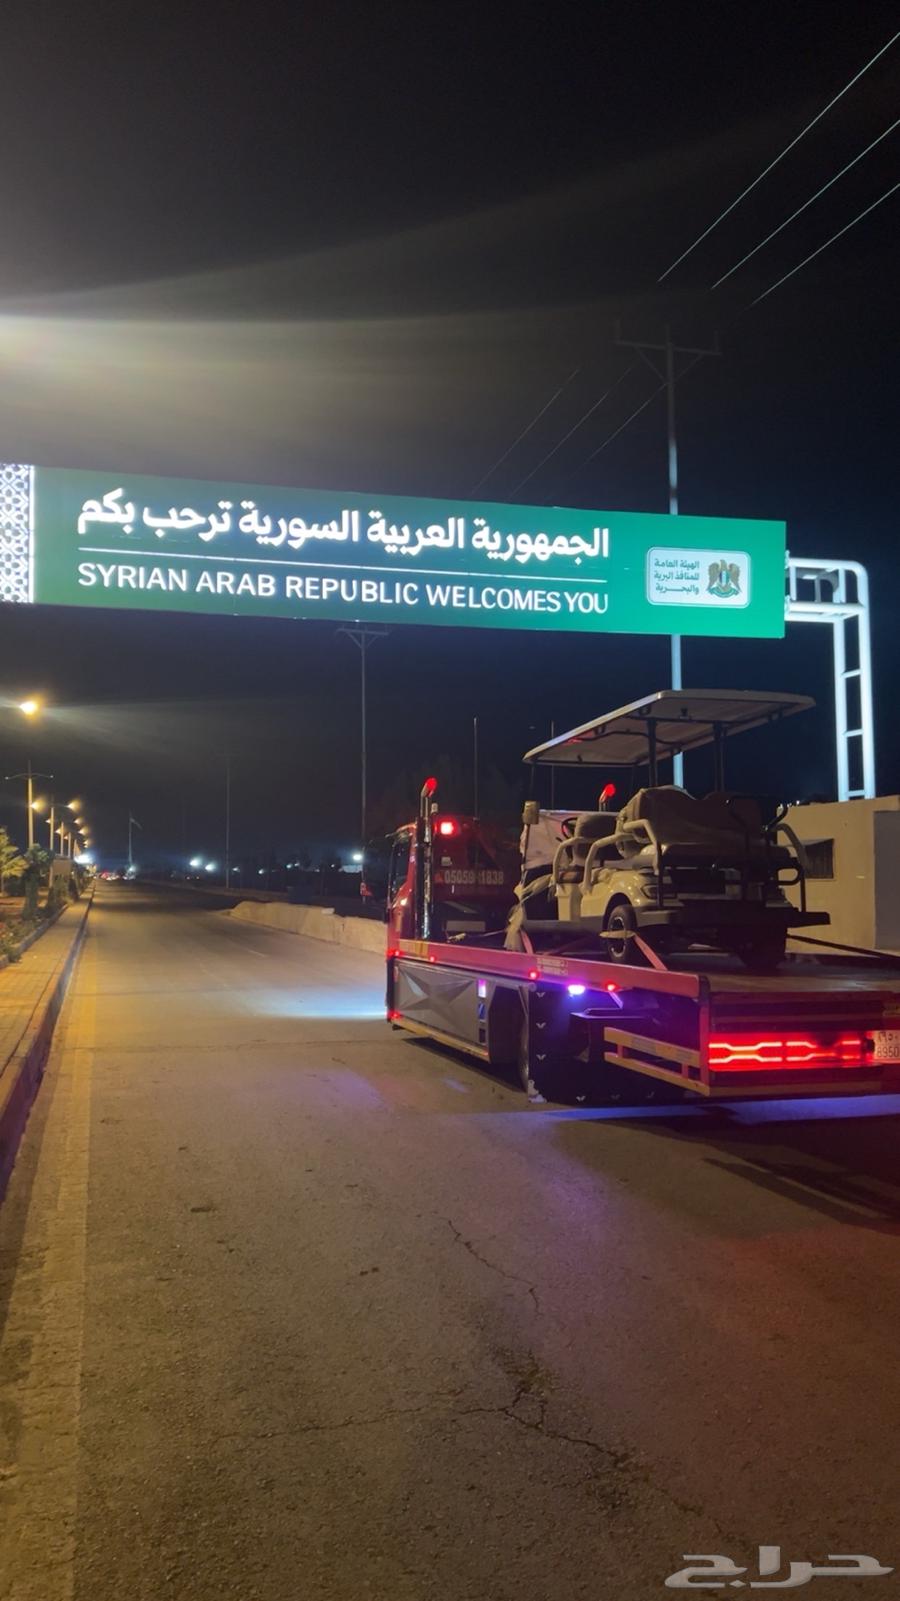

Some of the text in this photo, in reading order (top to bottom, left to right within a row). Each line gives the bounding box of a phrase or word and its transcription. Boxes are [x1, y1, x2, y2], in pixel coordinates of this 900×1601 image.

[77, 487, 609, 565] الجمهورية العربية السورية ترحب بكم
[653, 569, 700, 582] للمنافذ البرية
[654, 558, 700, 571] الهيئة العامة
[78, 562, 188, 593] SYRIAN
[195, 571, 276, 599] ARAB
[285, 575, 419, 606] REPUBLIC
